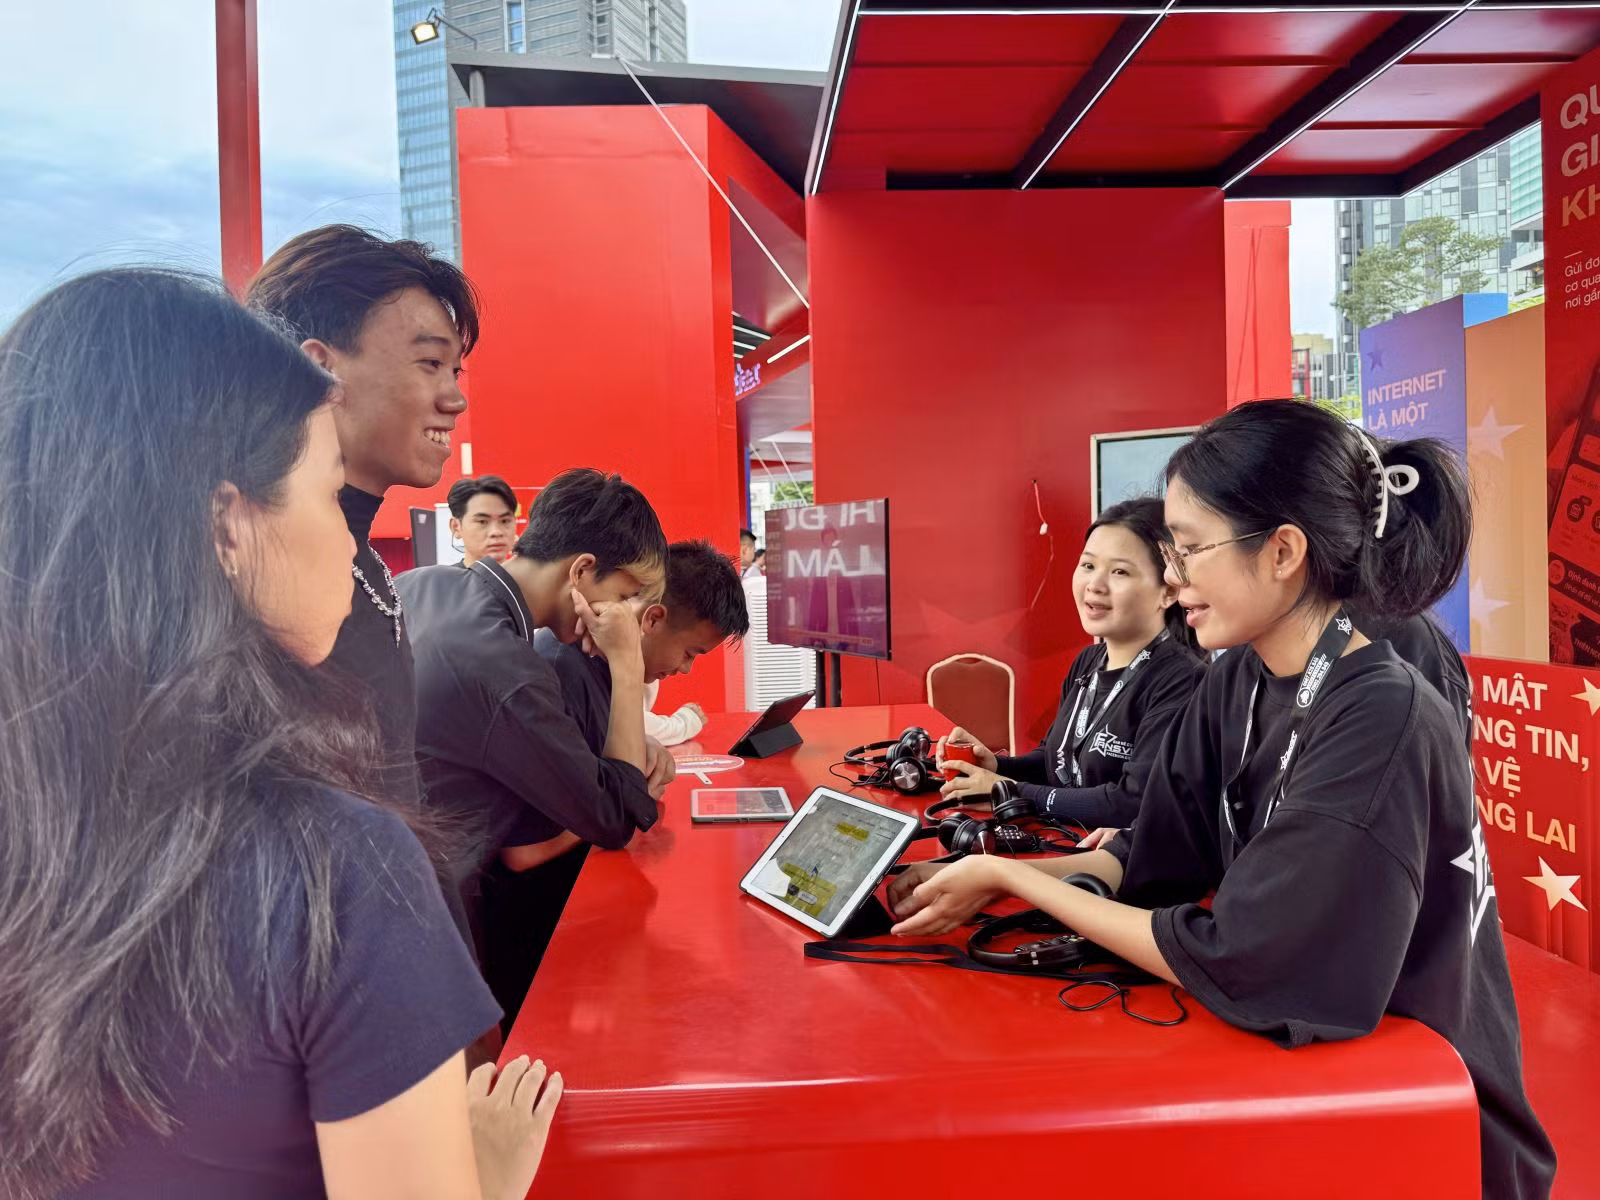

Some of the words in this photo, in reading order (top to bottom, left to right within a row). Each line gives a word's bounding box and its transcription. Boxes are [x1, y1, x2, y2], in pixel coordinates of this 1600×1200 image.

[1367, 369, 1447, 406] INTERNET
[1368, 408, 1389, 432] LÀ
[1391, 400, 1429, 427] MỘT
[1482, 672, 1548, 715] MẬT
[1472, 714, 1516, 749] NG
[1524, 724, 1589, 772] TIN,
[1482, 755, 1521, 798] VỆ
[1475, 794, 1516, 833] NG
[1526, 810, 1576, 854] LAI
